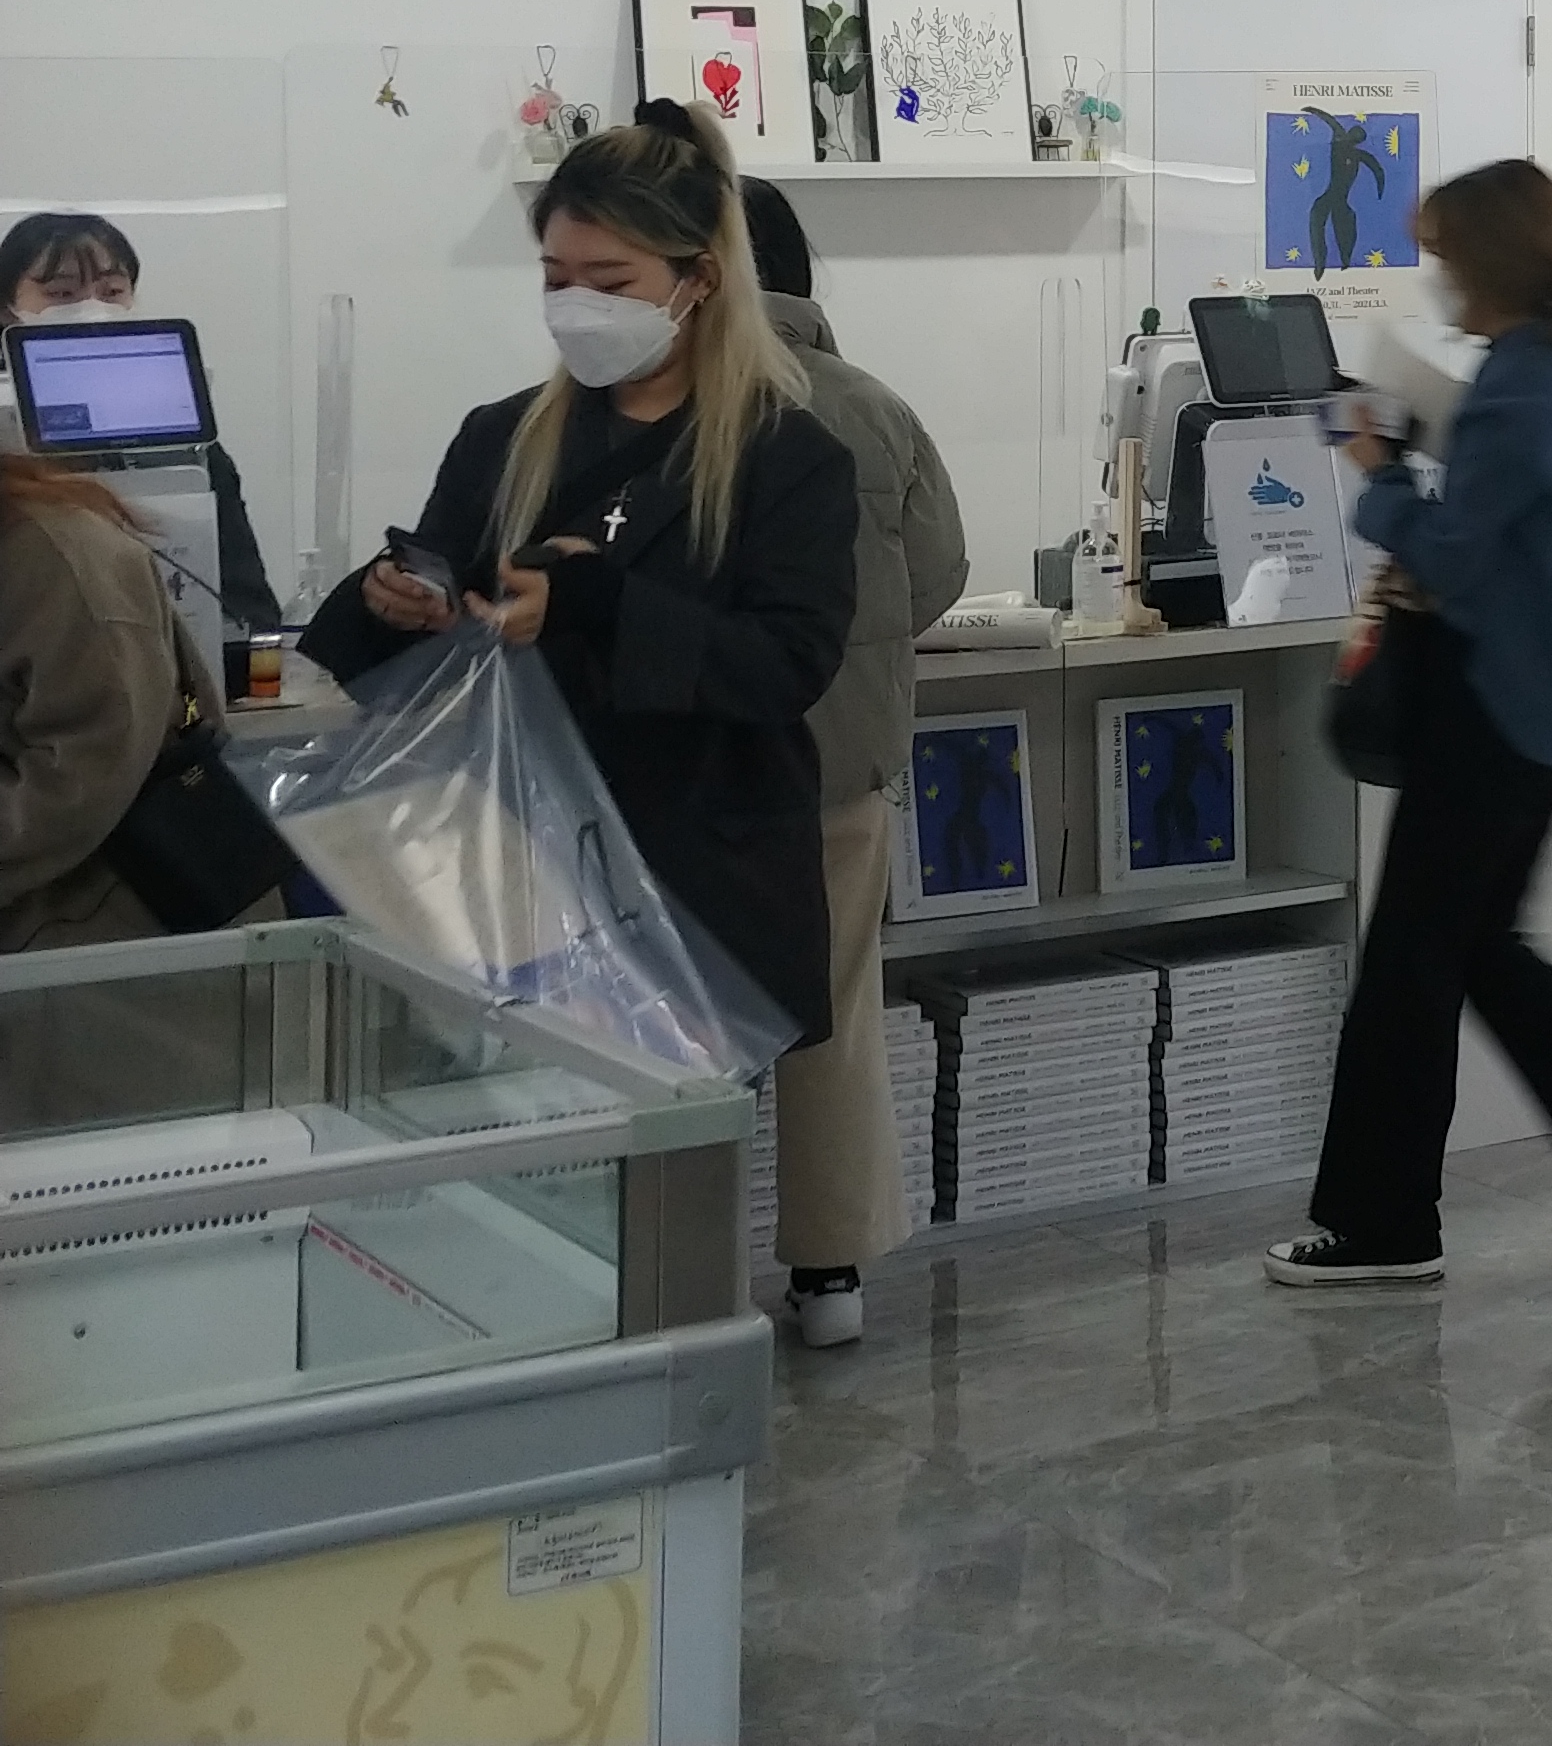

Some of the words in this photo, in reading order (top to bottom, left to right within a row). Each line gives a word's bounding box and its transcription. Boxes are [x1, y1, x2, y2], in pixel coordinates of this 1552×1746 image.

[1292, 84, 1335, 97] HENRI
[1337, 85, 1393, 97] MATISSE
[1328, 286, 1345, 295] and
[1346, 286, 1380, 295] Theater
[931, 614, 1000, 628] ATISSE
[1114, 748, 1122, 790] MATISSE
